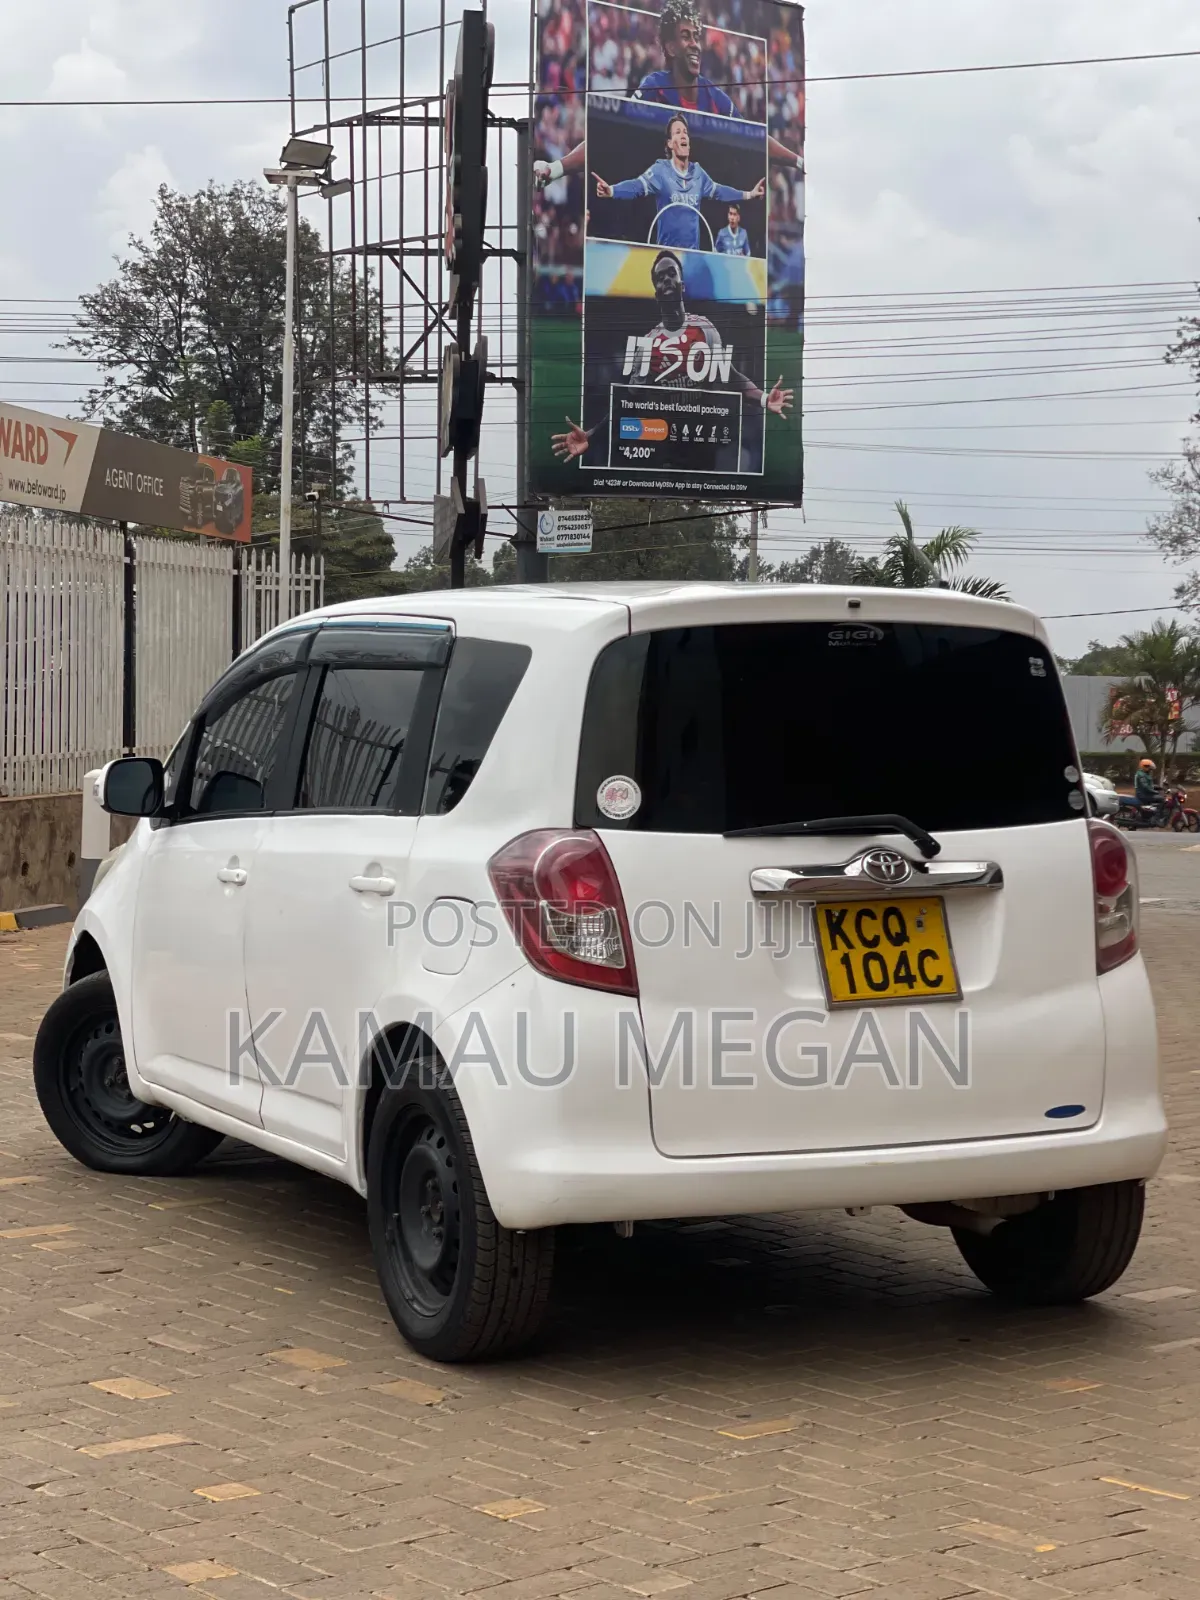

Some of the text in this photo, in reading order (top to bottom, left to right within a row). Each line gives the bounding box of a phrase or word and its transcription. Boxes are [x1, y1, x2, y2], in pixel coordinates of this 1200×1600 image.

[622, 335, 733, 383] IT'S ON
[620, 400, 729, 417] The world's best football package
[644, 426, 665, 434] Compact
[623, 446, 651, 459] 4,200
[8, 477, 67, 504] www.befoward.jp
[104, 468, 164, 497] AGENT OFFICE
[628, 480, 655, 488] Download
[675, 482, 686, 490] App
[692, 483, 702, 491] stay
[827, 630, 875, 640] GIGI
[825, 906, 910, 951] KCQ
[840, 948, 944, 994] 104C
